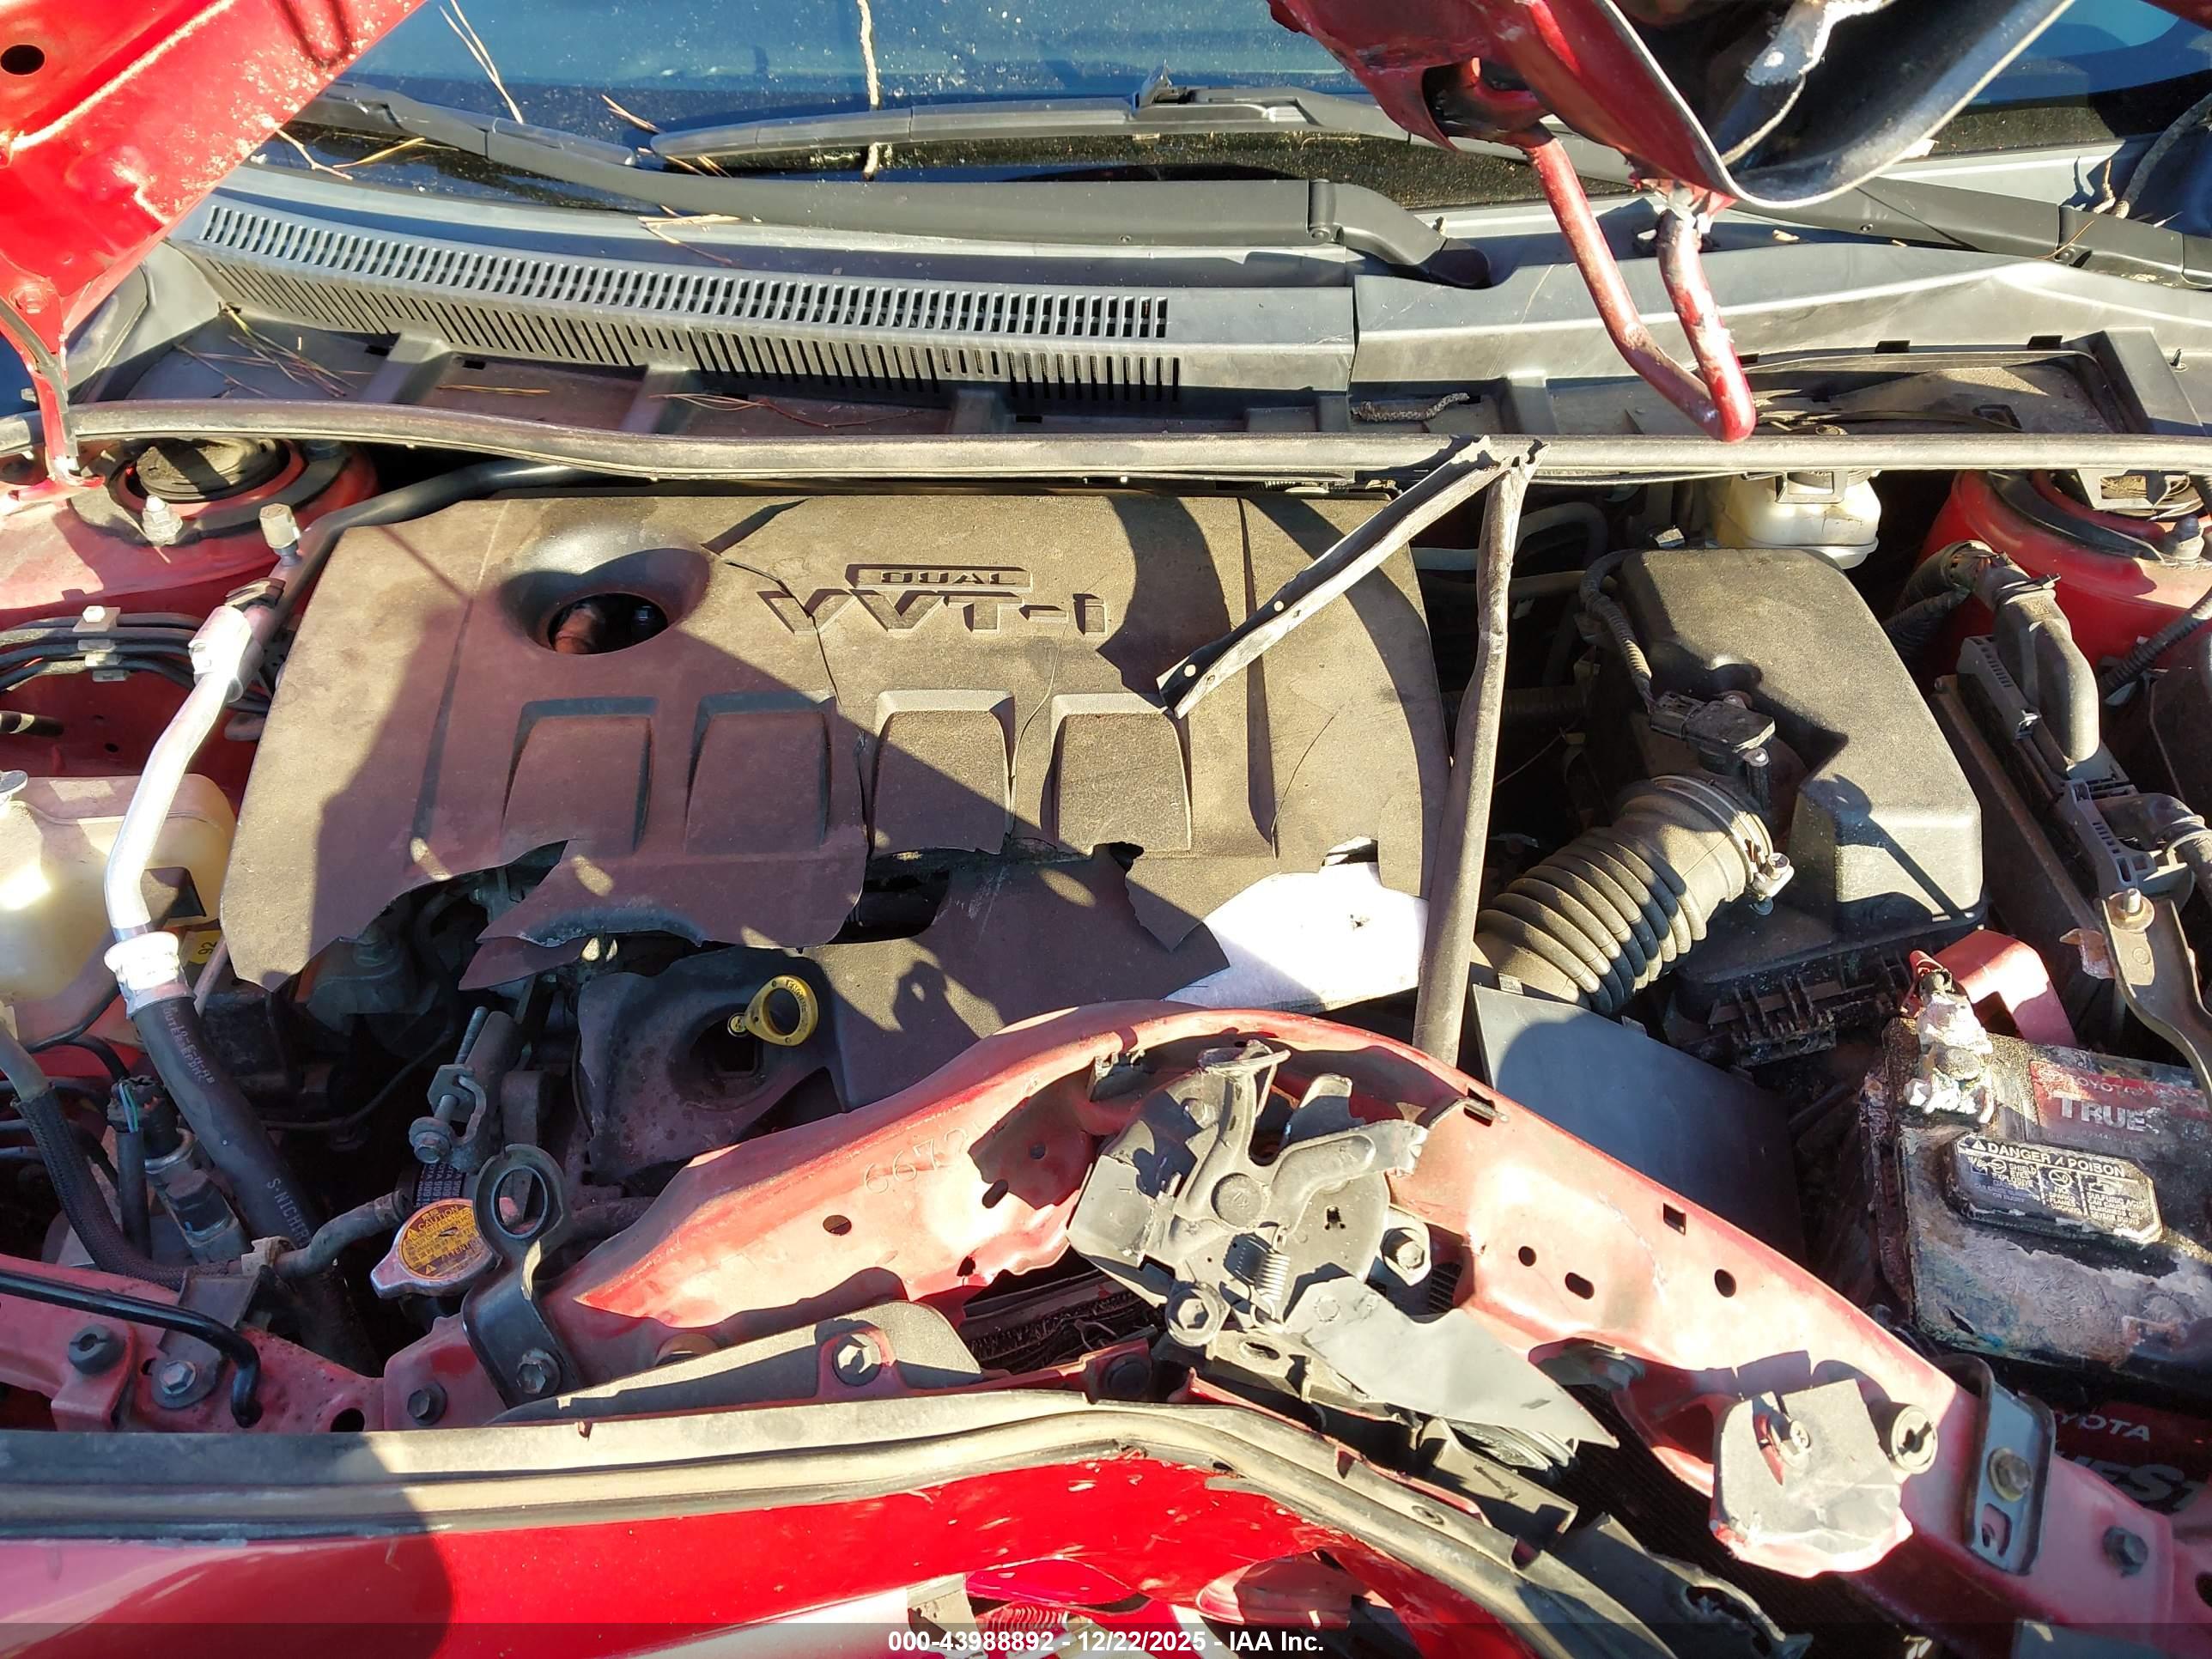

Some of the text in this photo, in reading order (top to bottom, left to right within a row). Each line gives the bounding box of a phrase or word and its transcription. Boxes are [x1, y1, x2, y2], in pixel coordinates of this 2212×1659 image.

[880, 570, 1017, 586] DUAL
[1987, 1142, 2051, 1164] DANGER
[2067, 1158, 2125, 1177] POISON
[2009, 1163, 2037, 1176] SHIELD
[2009, 1170, 2031, 1180] EYES
[1992, 1172, 2034, 1188] EXPLOSIVE
[417, 1205, 459, 1231] CAUTION
